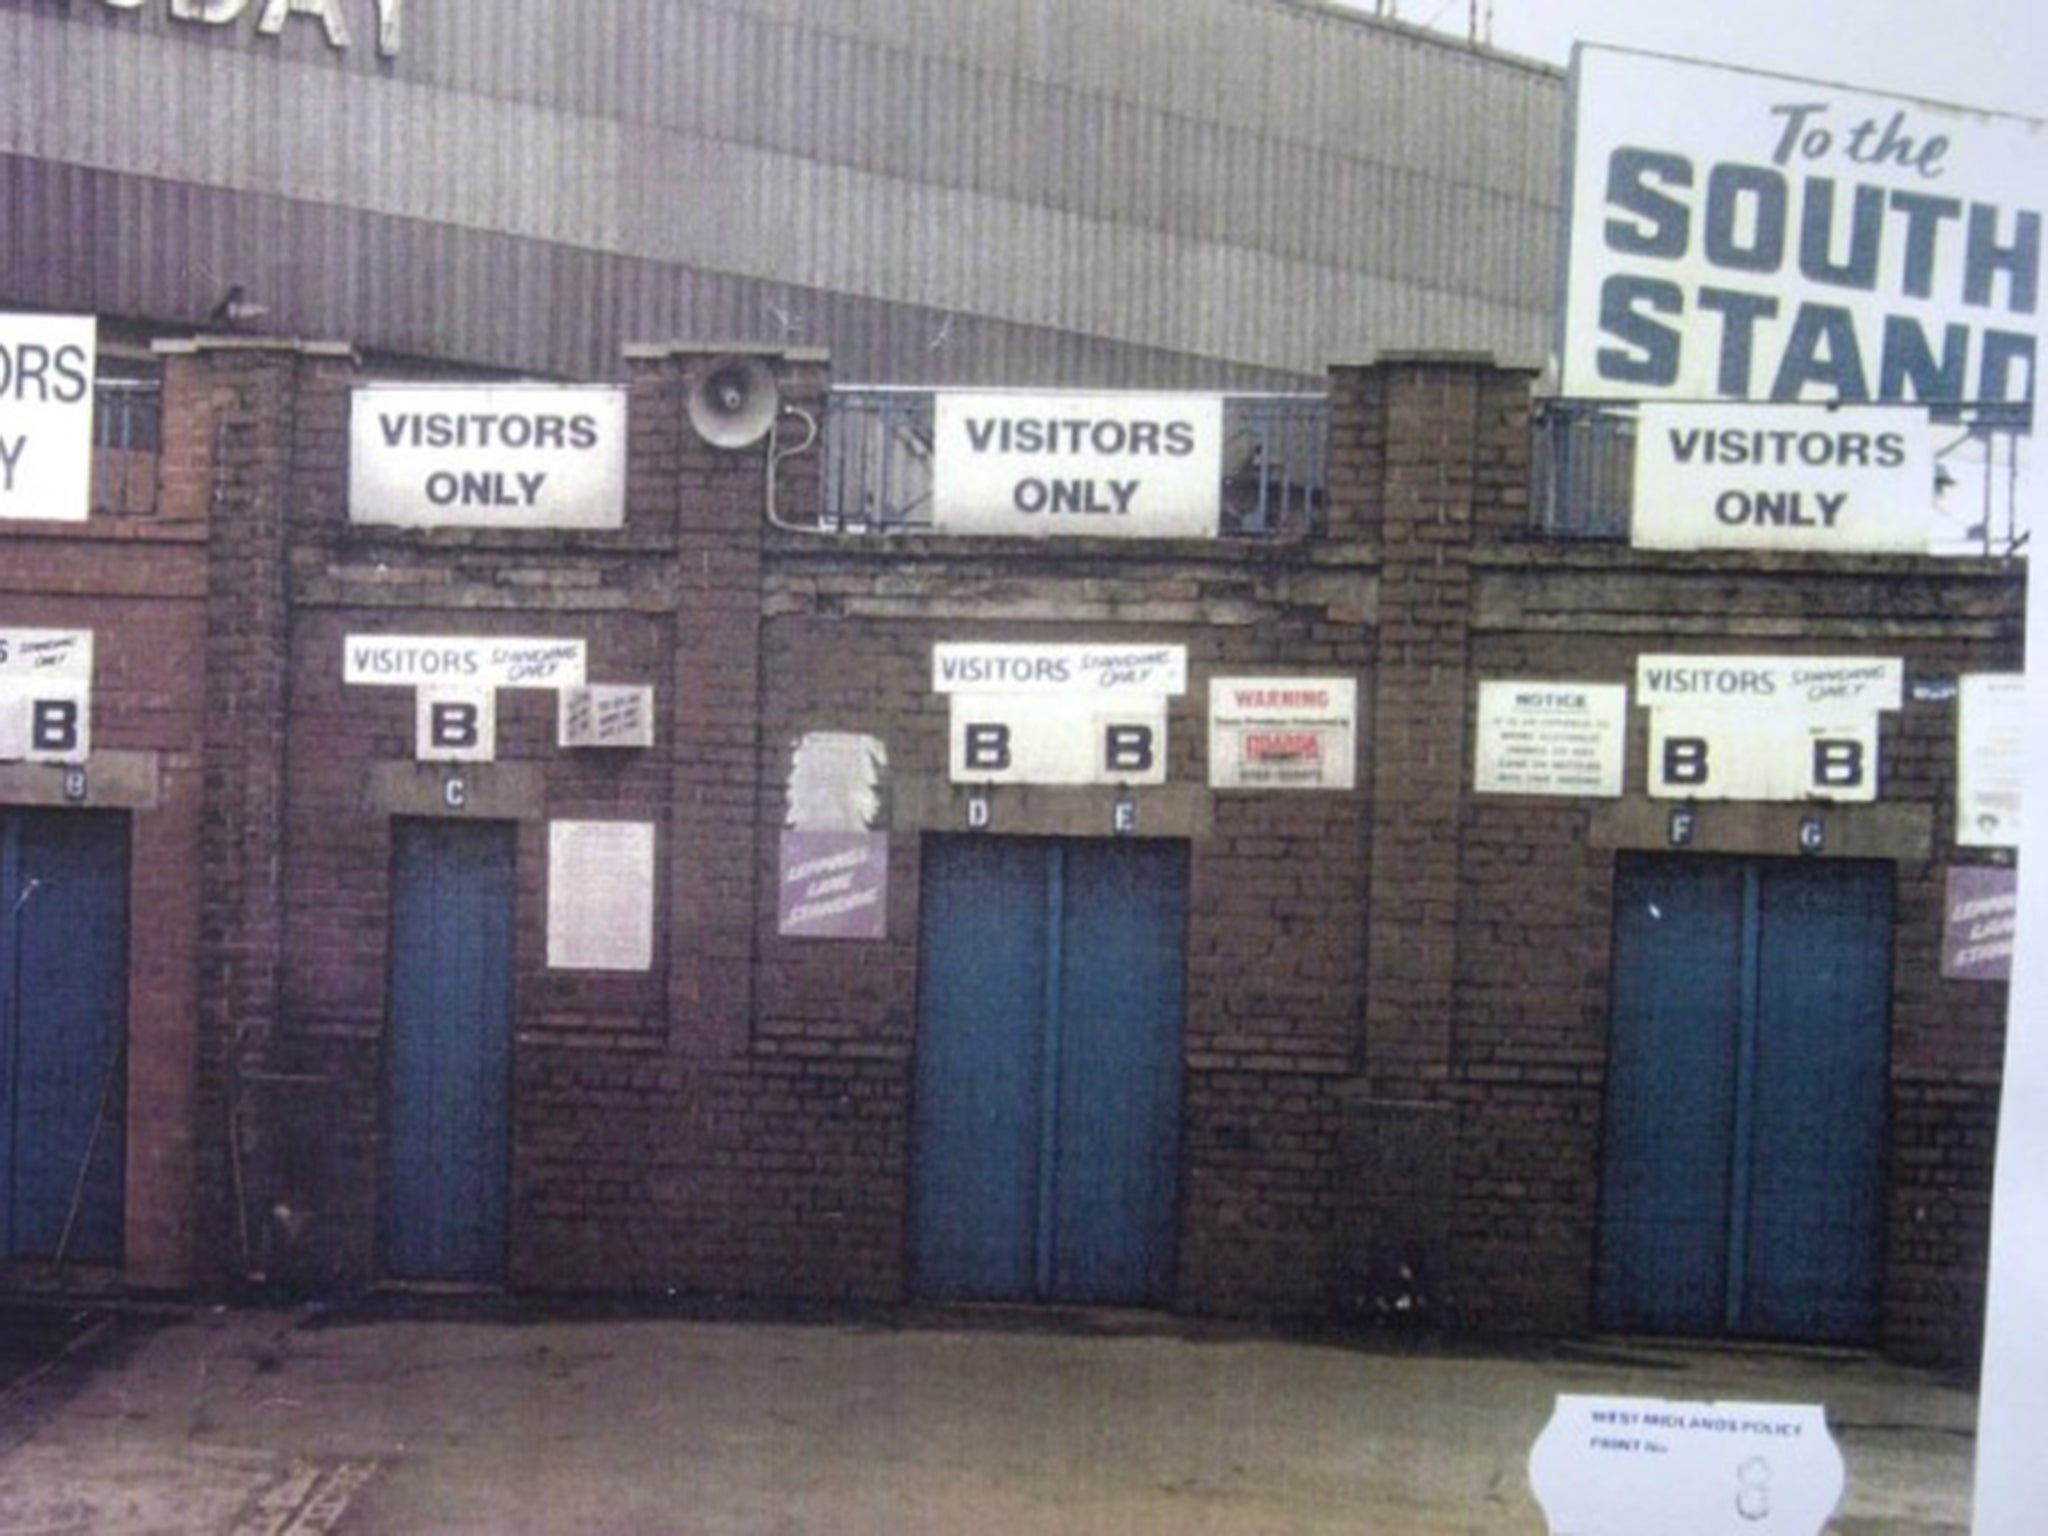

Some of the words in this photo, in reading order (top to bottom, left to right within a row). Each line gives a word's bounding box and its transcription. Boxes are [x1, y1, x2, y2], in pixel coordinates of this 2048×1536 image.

[1771, 103, 1835, 166] To
[1845, 111, 1949, 177] the
[1604, 144, 2042, 315] SOUTH
[1596, 272, 2037, 434] STAND
[378, 412, 599, 449] VISITORS
[964, 418, 1195, 456] VISITORS
[1668, 428, 1905, 467] VISITORS
[425, 471, 547, 506] ONLY
[1013, 477, 1140, 514] ONLY
[1715, 489, 1849, 527] ONLY
[354, 648, 479, 675] VISITORS
[941, 656, 1071, 682] VISITORS
[1234, 690, 1330, 708] WARNING
[1646, 668, 1776, 695] VISITORS
[1515, 694, 1586, 707] NOTICE
[33, 699, 78, 750] B
[431, 702, 478, 748] B
[965, 723, 1011, 770] B
[1106, 724, 1153, 773] B
[1663, 736, 1709, 784] B
[1813, 739, 1863, 788] B
[445, 779, 464, 806] C
[968, 799, 988, 827] D
[1115, 803, 1134, 831] E
[1672, 815, 1691, 842] F
[1801, 822, 1822, 847] G
[1591, 1411, 1639, 1426] WEST
[1643, 1412, 1737, 1433] MIDLANDS
[1741, 1422, 1803, 1436] POLICE
[1589, 1436, 1641, 1452] PRINT
[1736, 1455, 1771, 1522] 8
